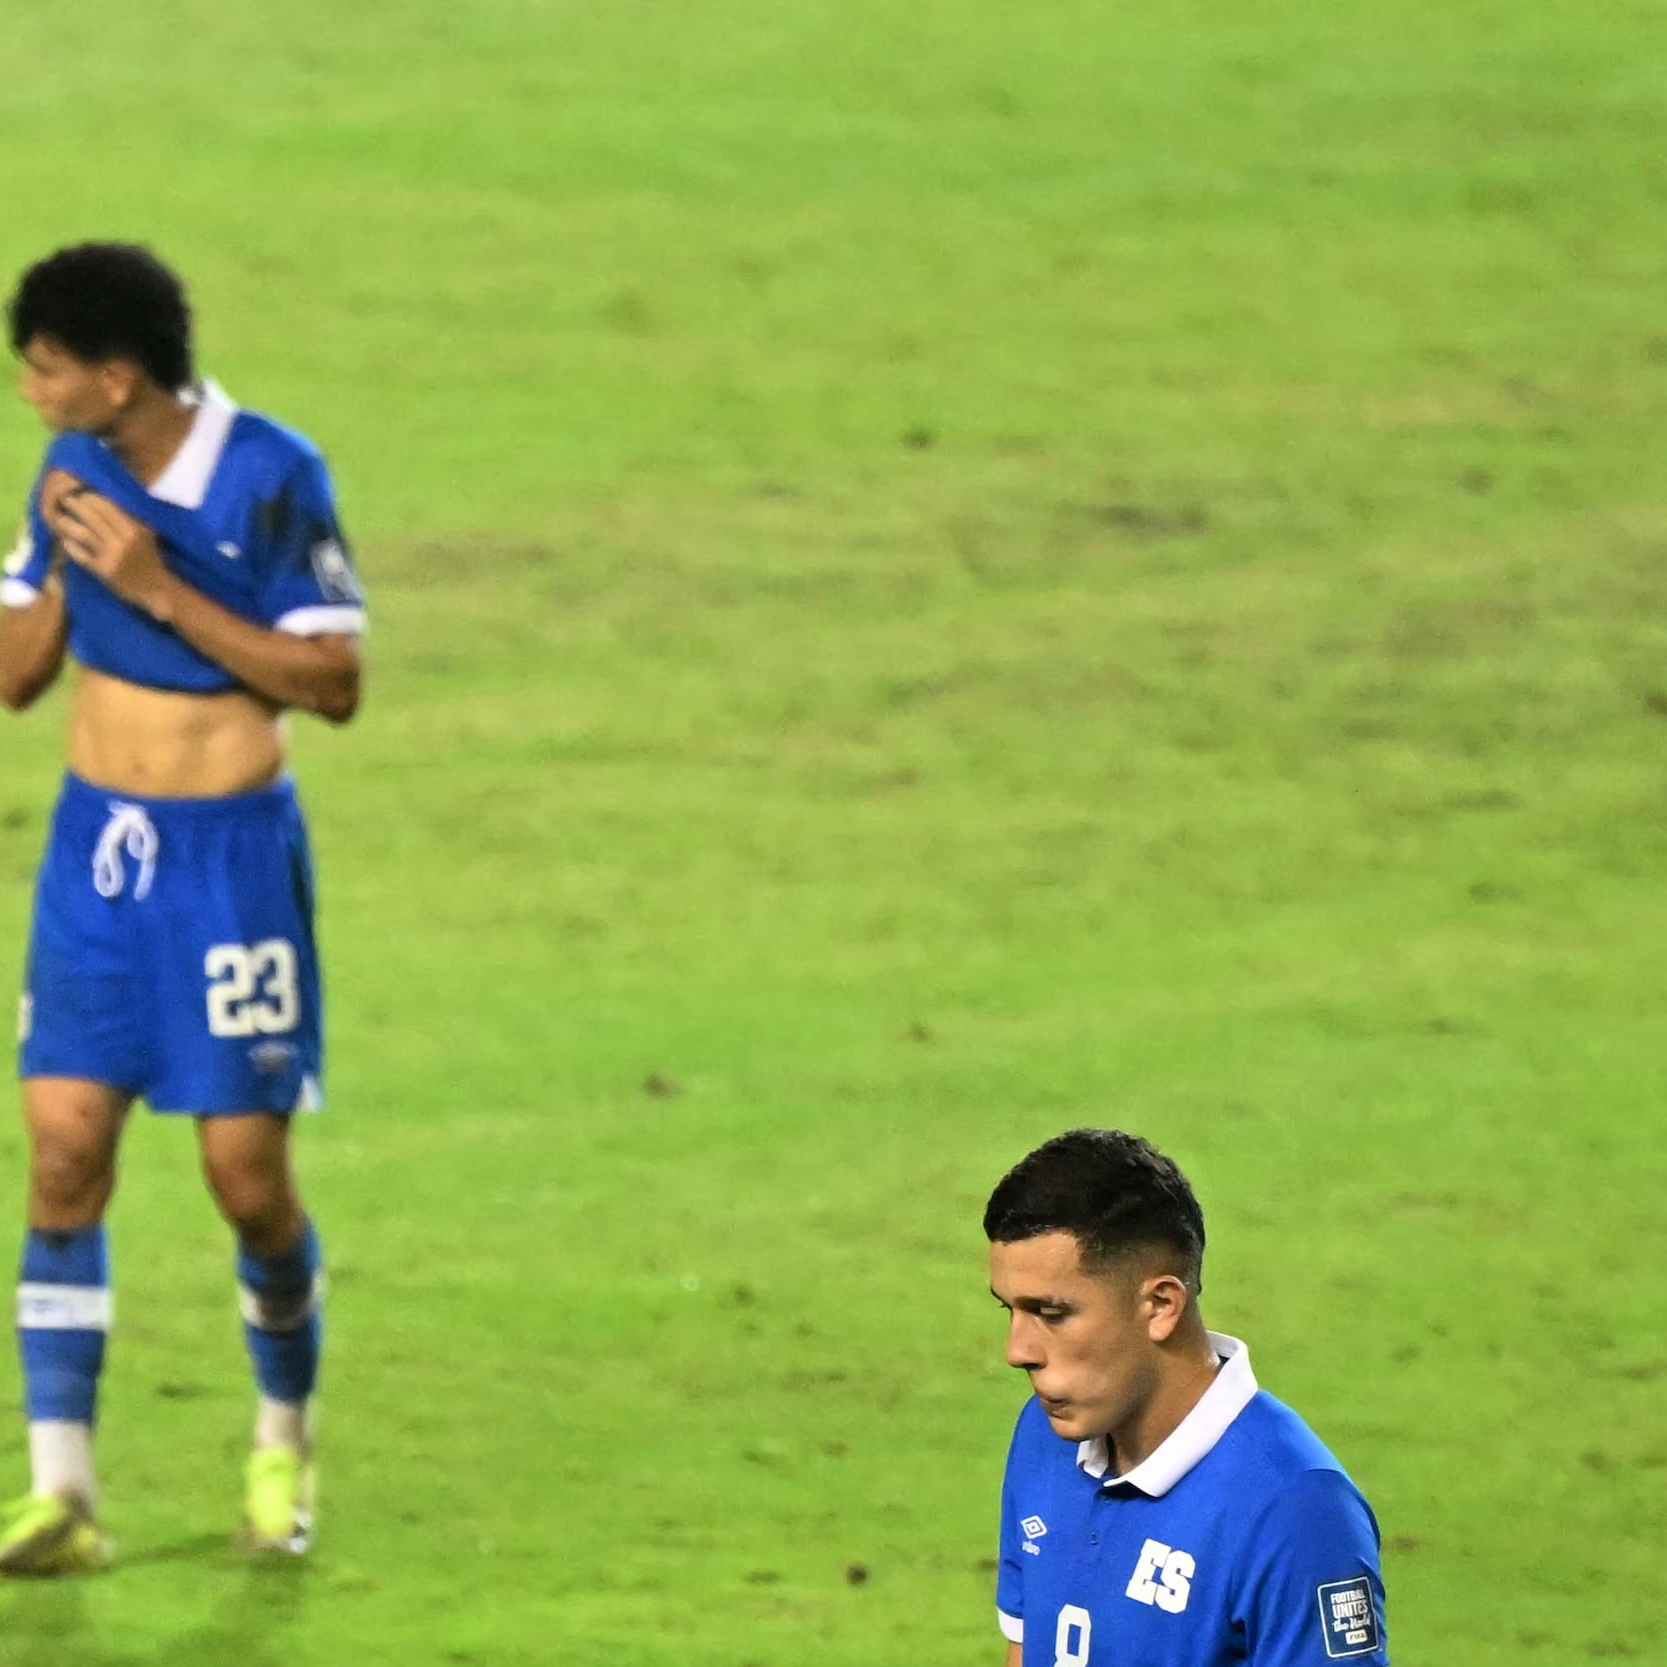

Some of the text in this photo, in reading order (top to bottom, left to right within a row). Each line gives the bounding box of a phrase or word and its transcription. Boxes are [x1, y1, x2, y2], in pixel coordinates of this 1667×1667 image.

[204, 938, 299, 1038] 23
[1125, 1538, 1196, 1614] ES
[1332, 1599, 1368, 1619] UNITES
